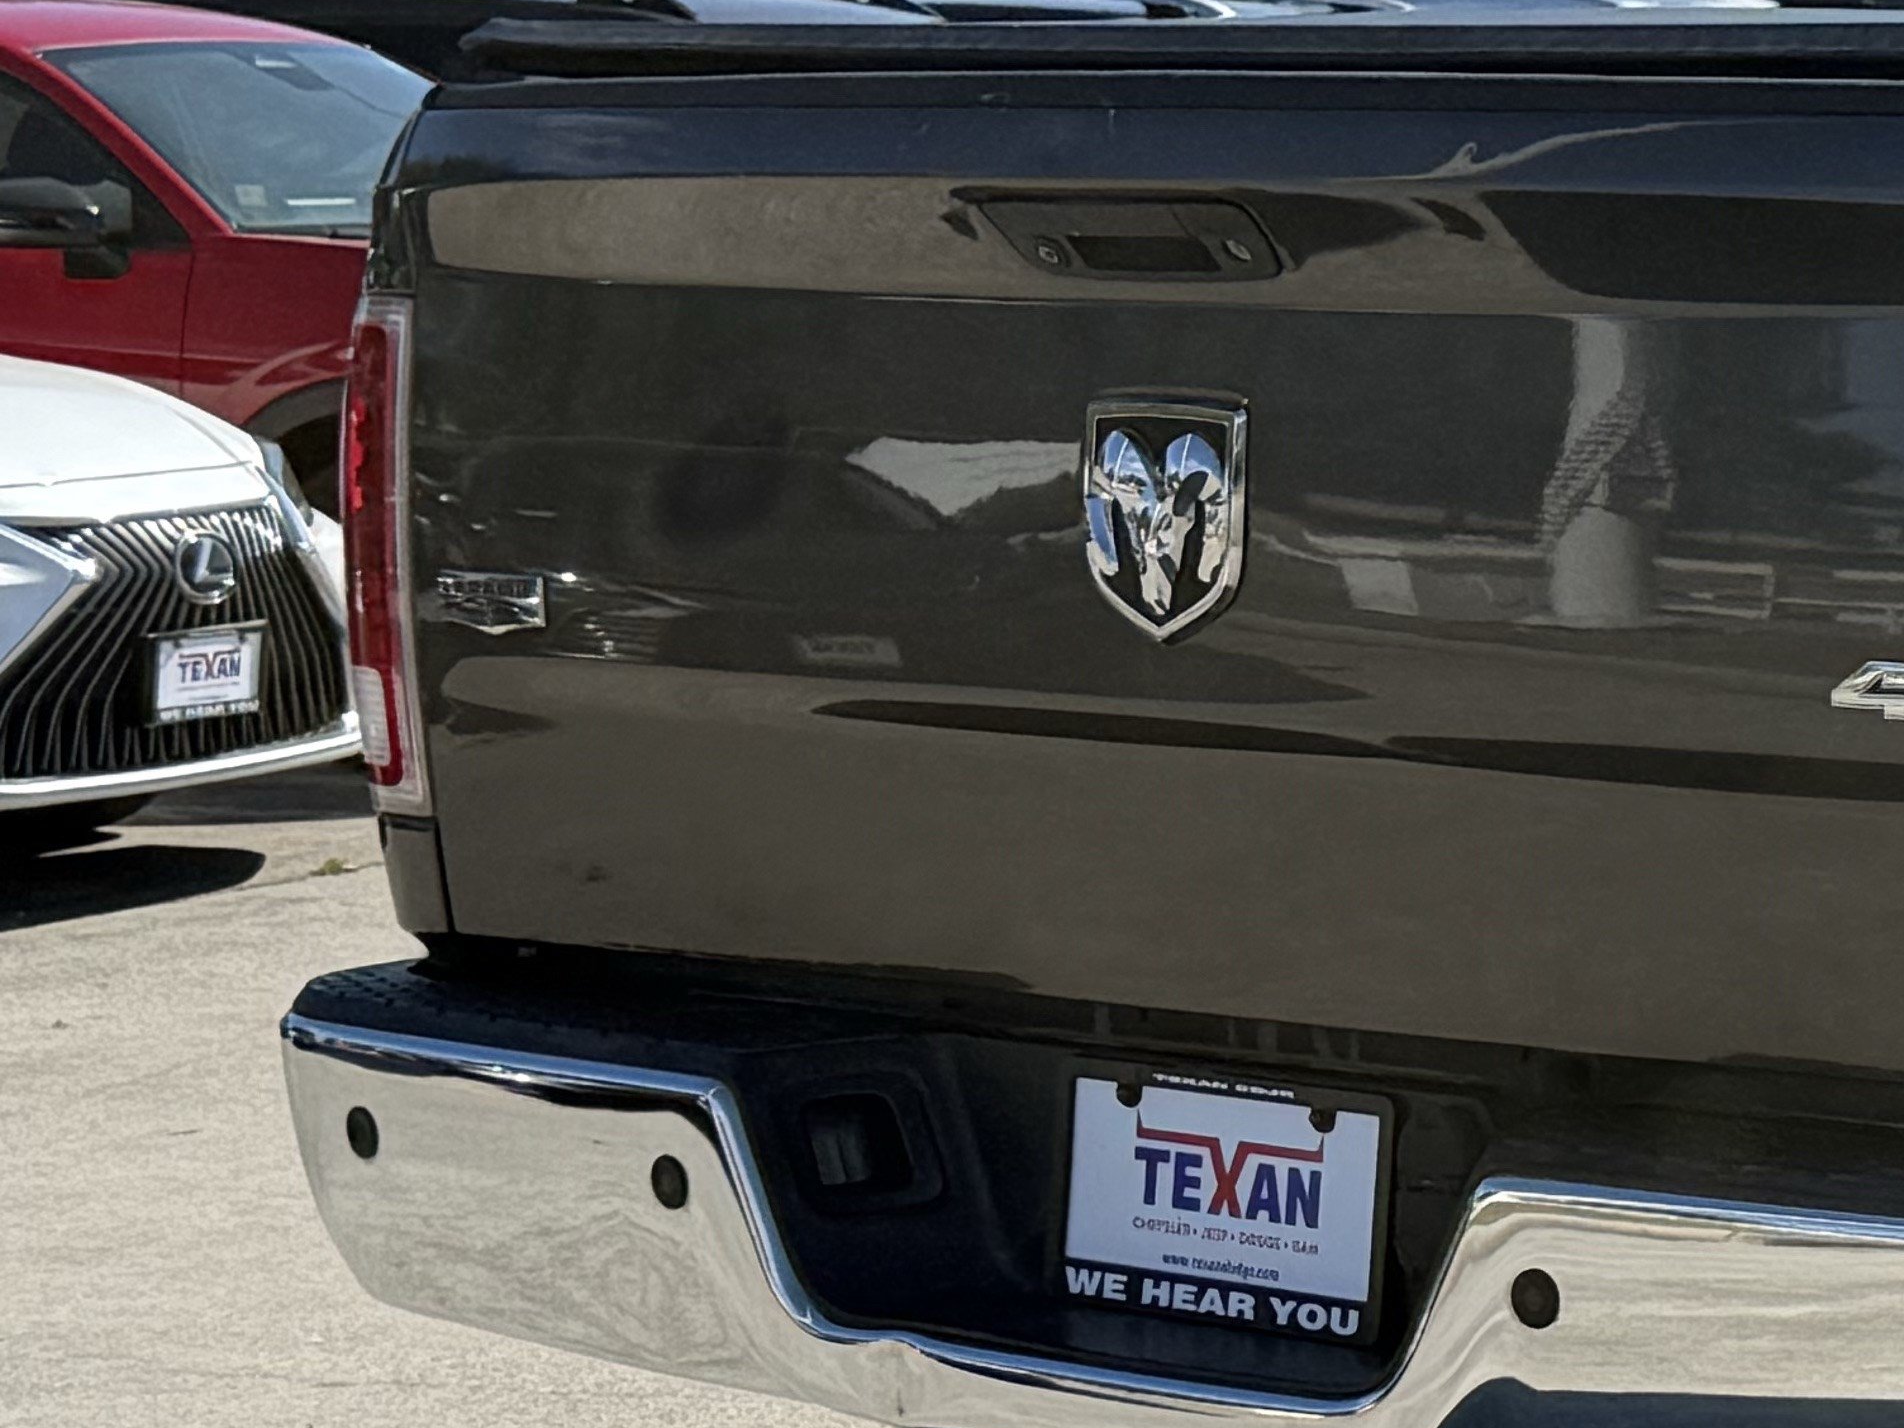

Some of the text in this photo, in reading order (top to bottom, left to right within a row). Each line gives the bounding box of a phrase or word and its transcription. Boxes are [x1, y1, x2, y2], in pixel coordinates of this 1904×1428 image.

[178, 648, 241, 684] TEXAN
[1134, 1122, 1324, 1229] TEXAN
[1064, 1265, 1361, 1337] WE HEAR YOU
